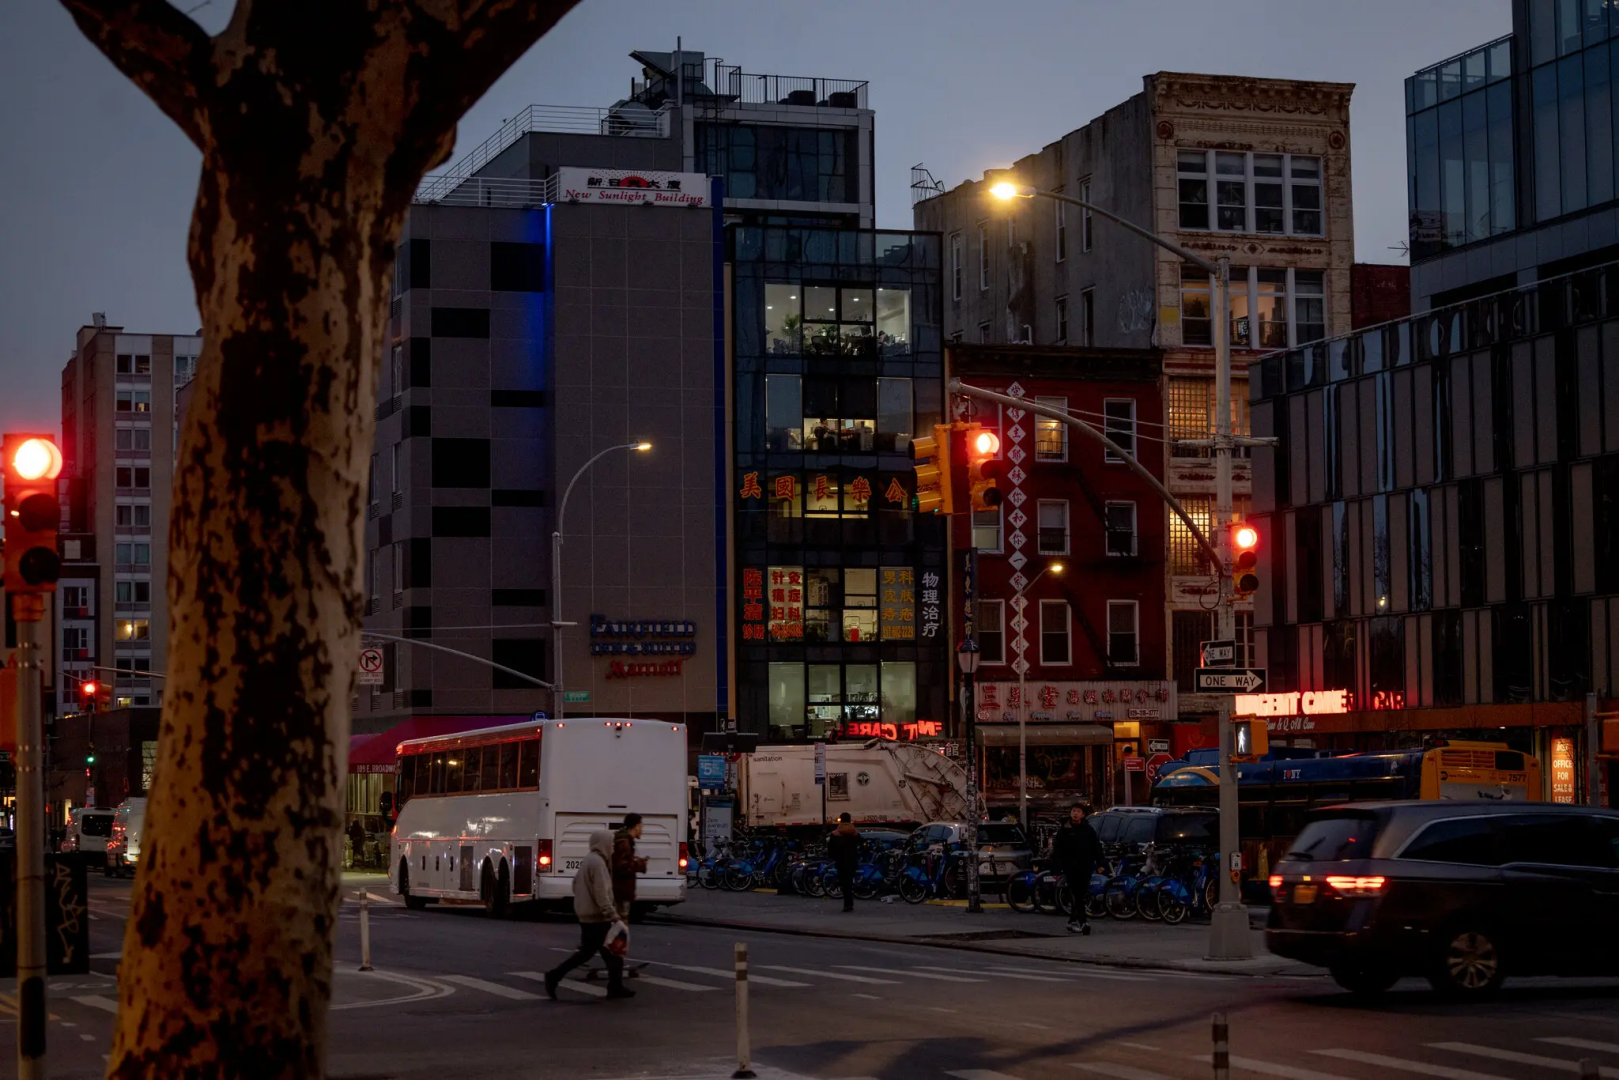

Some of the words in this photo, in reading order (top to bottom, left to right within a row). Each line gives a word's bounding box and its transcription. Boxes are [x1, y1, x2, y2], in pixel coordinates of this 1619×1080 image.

[565, 189, 591, 199] New
[599, 190, 647, 202] Sunlight
[655, 193, 704, 205] Building
[740, 470, 929, 503] 美國長樂公
[921, 572, 940, 638] 物理治疗
[590, 614, 696, 638] FAIRFIELD
[1205, 650, 1215, 660] ONE
[1220, 648, 1230, 658] WAY
[605, 659, 682, 679] Marriott
[1205, 676, 1226, 686] ONE
[1235, 676, 1256, 686] WAY
[1553, 760, 1573, 768] OFFICE
[1557, 772, 1569, 780] FOR
